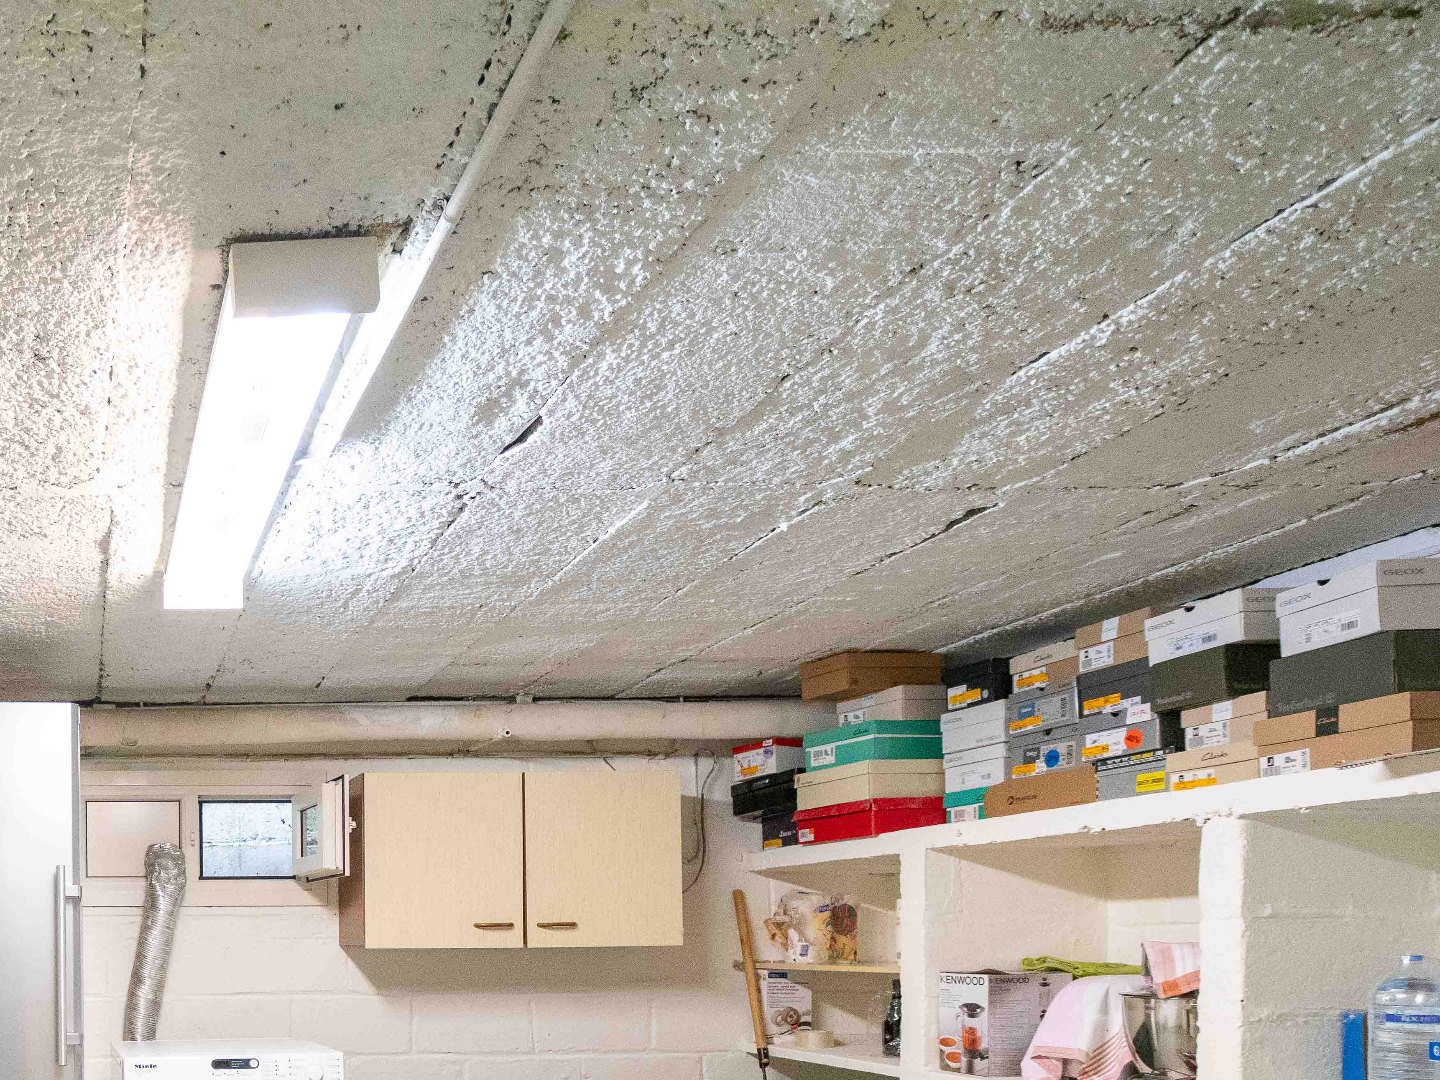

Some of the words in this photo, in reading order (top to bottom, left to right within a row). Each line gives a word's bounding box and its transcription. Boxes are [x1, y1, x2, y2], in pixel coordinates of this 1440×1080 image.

[1383, 567, 1425, 577] GEOX
[1279, 592, 1312, 608] GEOX
[1147, 618, 1176, 632] GEOX
[1201, 752, 1228, 761] Clarks
[940, 976, 985, 986] KENWOOD
